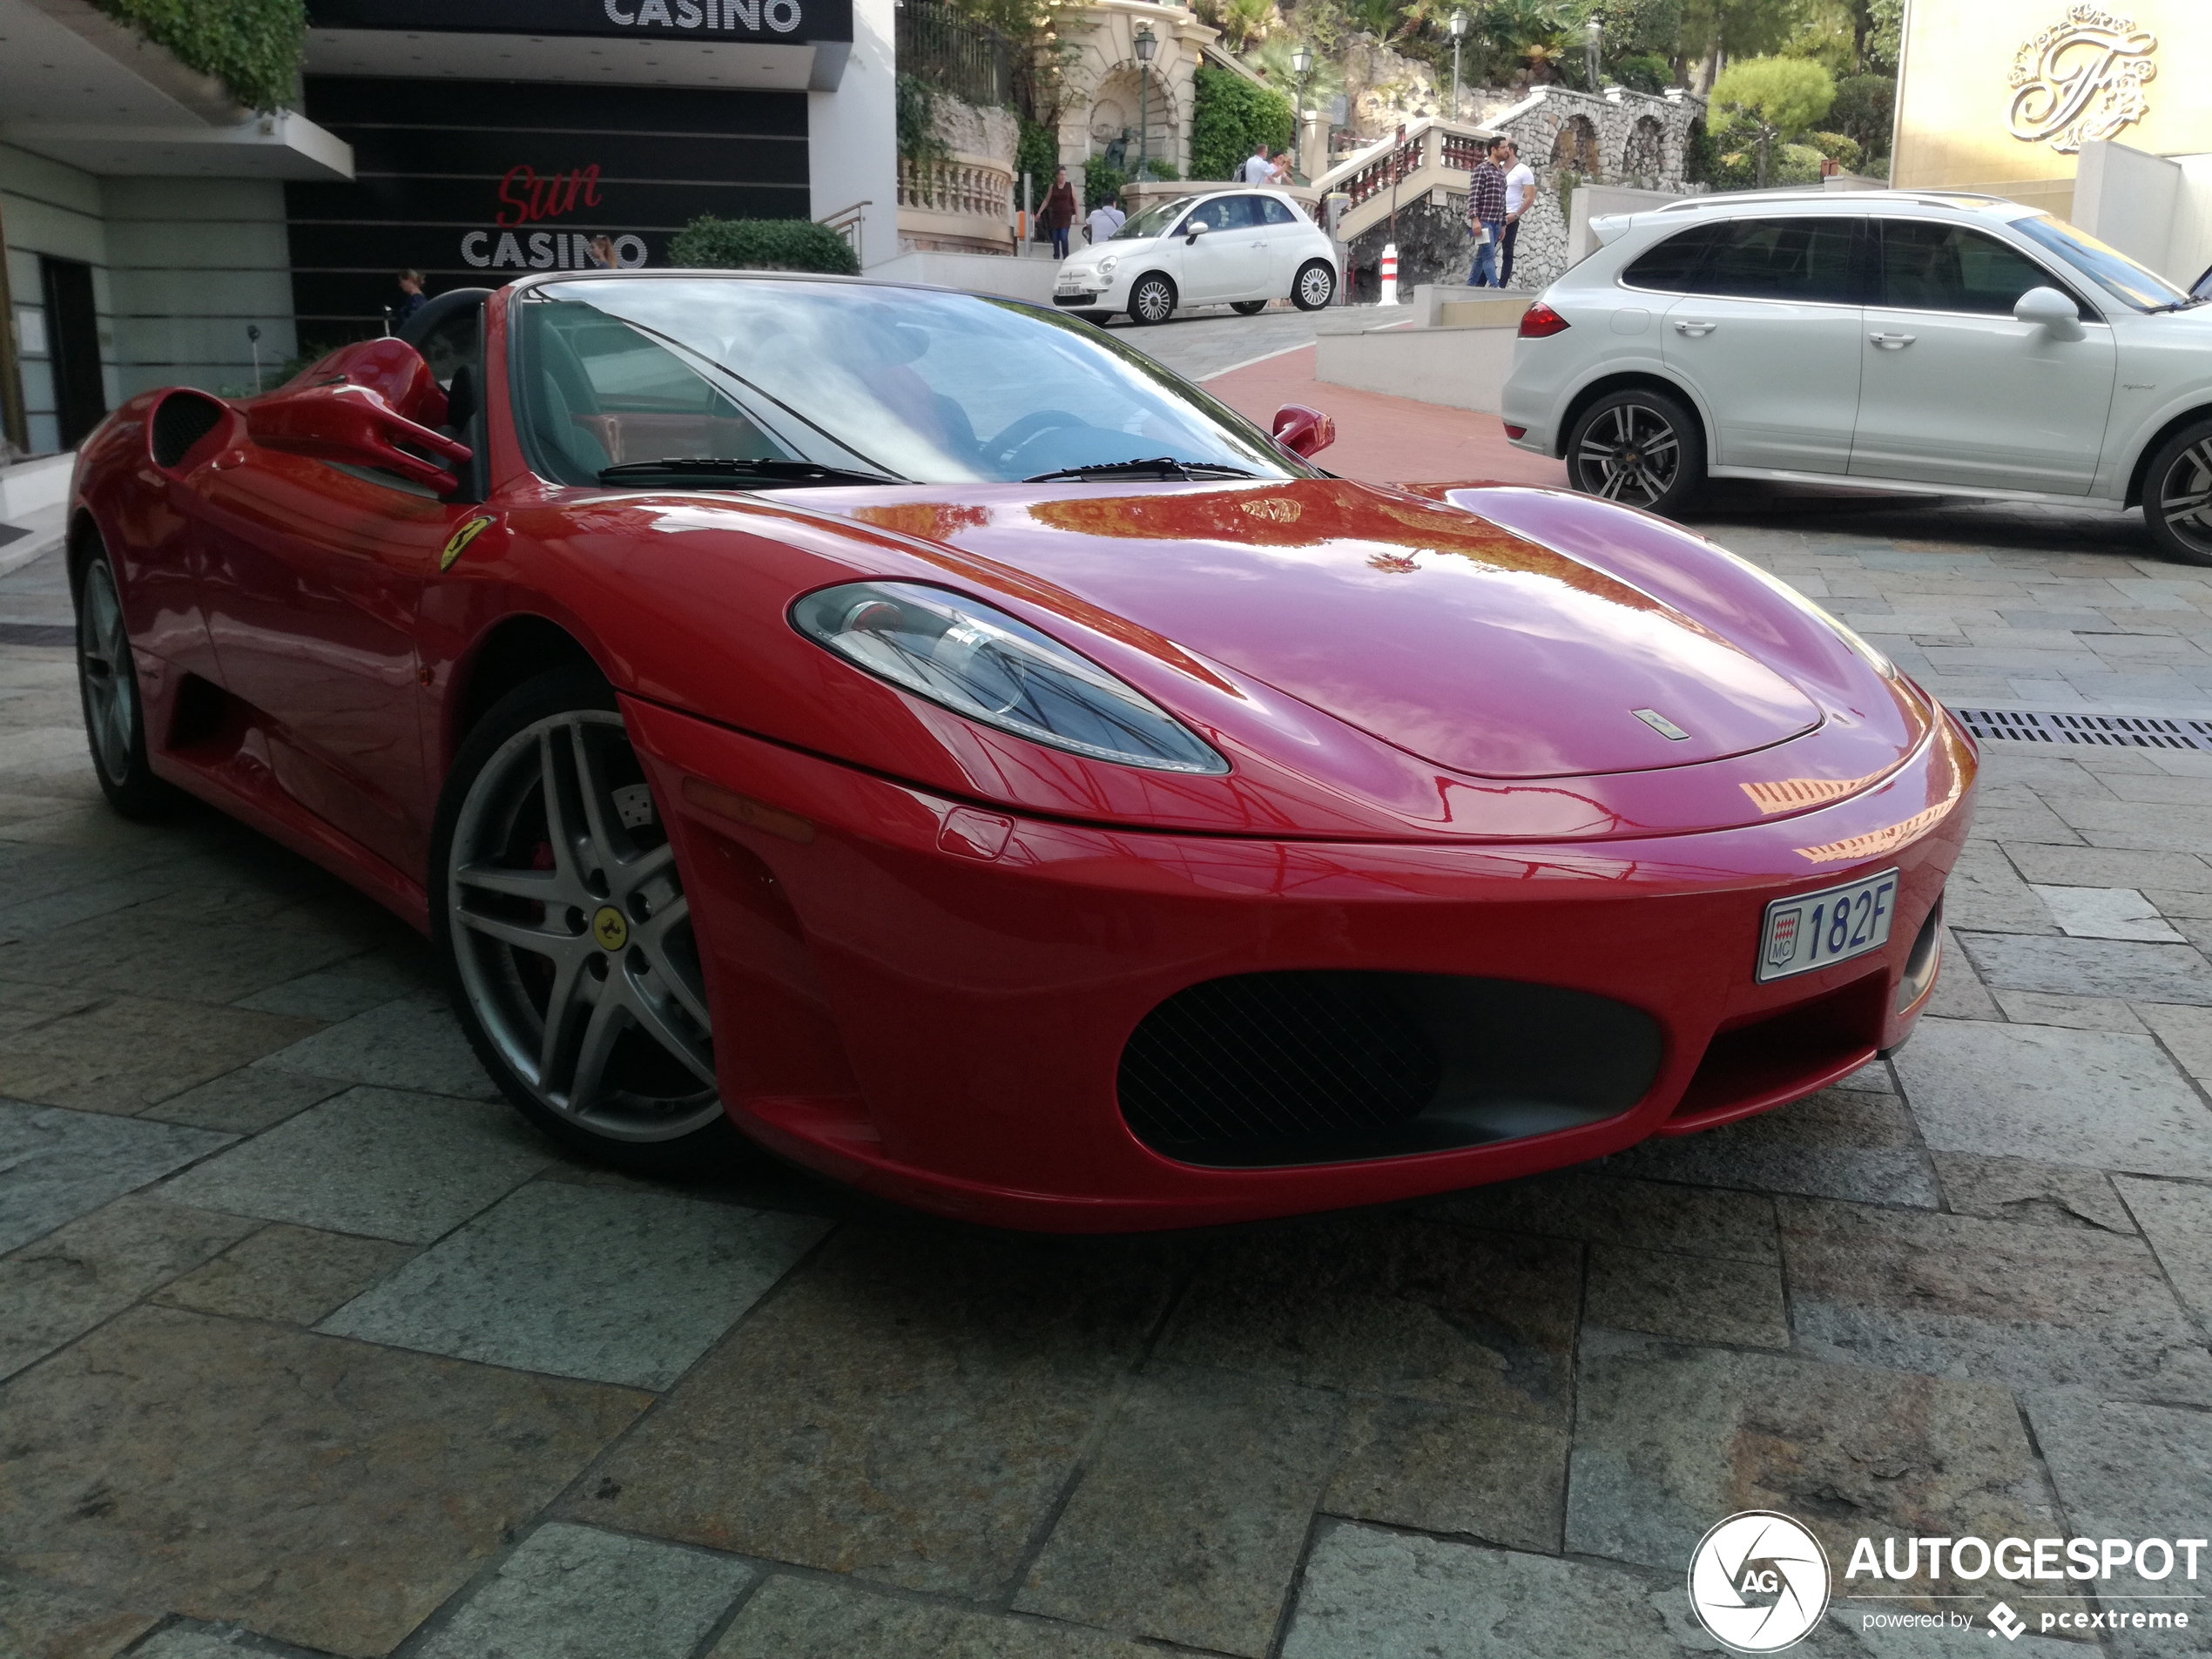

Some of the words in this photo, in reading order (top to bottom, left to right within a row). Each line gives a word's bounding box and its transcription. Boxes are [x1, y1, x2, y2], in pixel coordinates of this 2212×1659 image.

[604, 0, 801, 32] CASINO
[496, 164, 602, 228] Sun
[1810, 880, 1893, 960] 182F
[1772, 941, 1791, 959] MC
